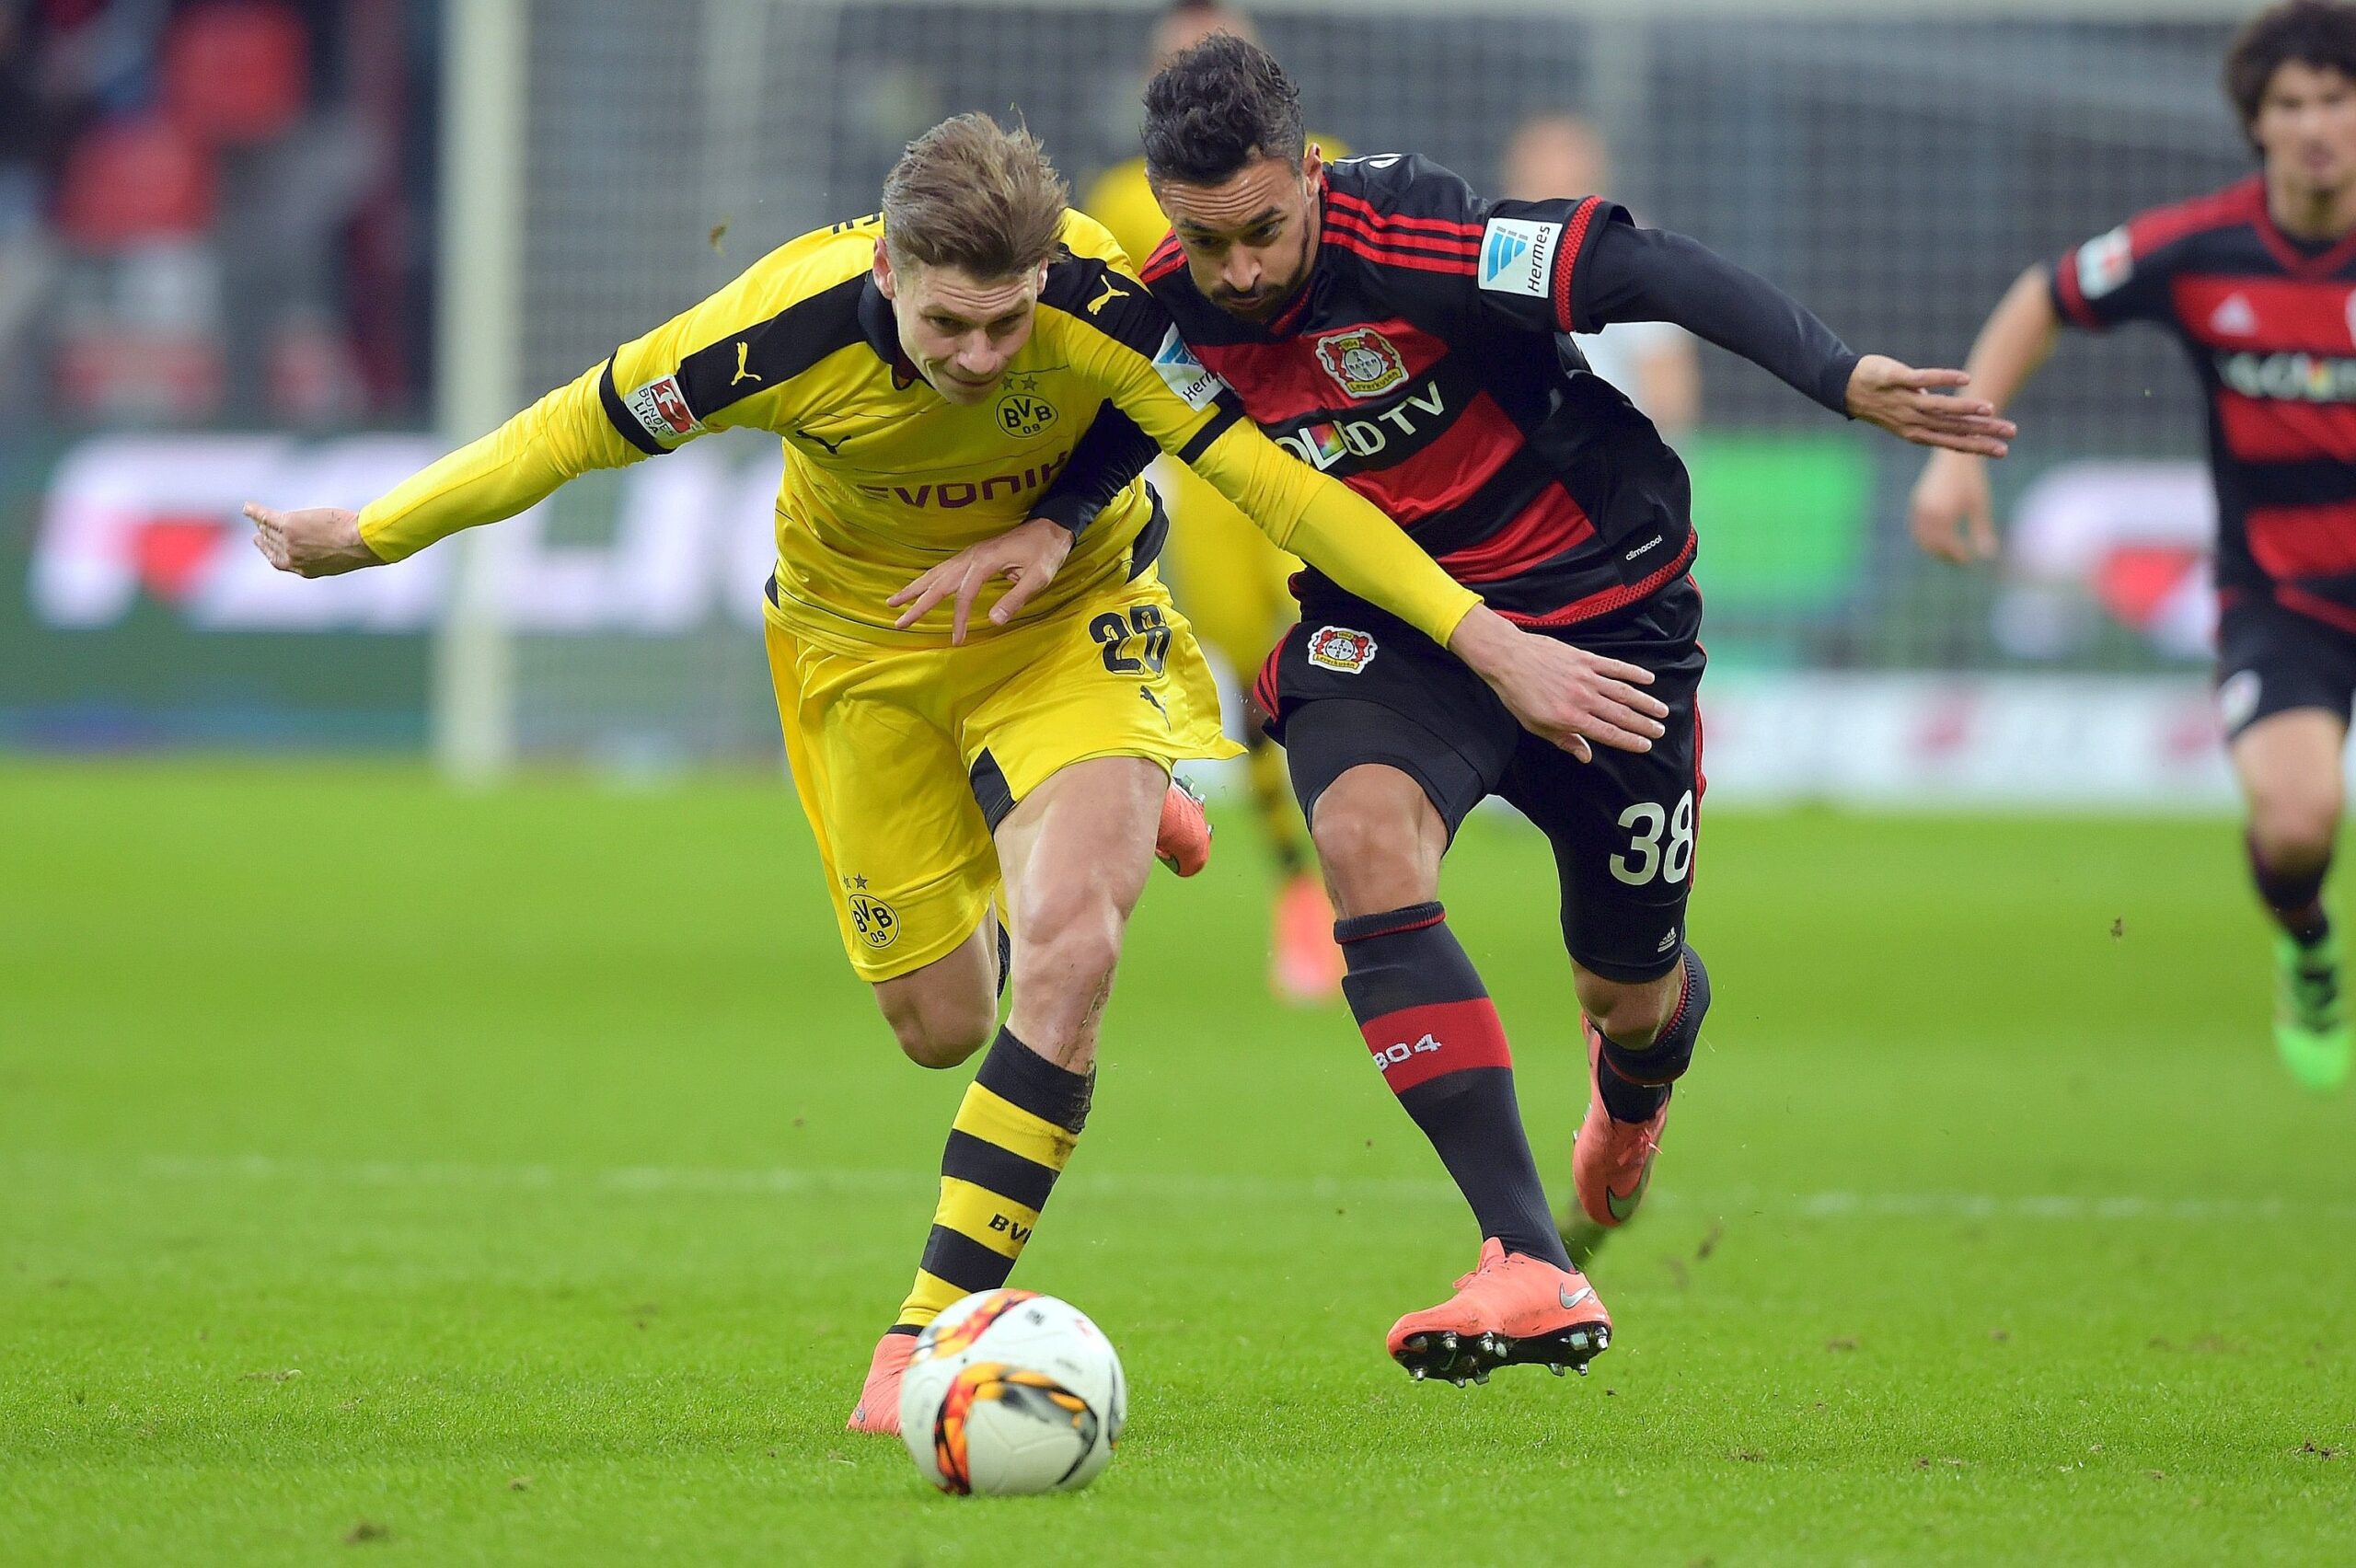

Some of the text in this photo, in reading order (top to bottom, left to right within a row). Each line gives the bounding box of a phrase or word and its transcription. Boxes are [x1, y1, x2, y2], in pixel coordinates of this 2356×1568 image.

[1527, 225, 1551, 293] Hermes
[1350, 371, 1398, 390] Leverkusen
[633, 402, 658, 433] LIGA
[638, 387, 674, 437] BUNDES
[1003, 398, 1052, 428] BVB
[1378, 380, 1444, 435] TV
[1625, 534, 1663, 560] climacool
[1088, 604, 1173, 679] 26
[1316, 654, 1356, 668] Leverkusen
[1609, 789, 1693, 886] 38
[852, 899, 893, 933] BVB
[870, 929, 887, 943] 09
